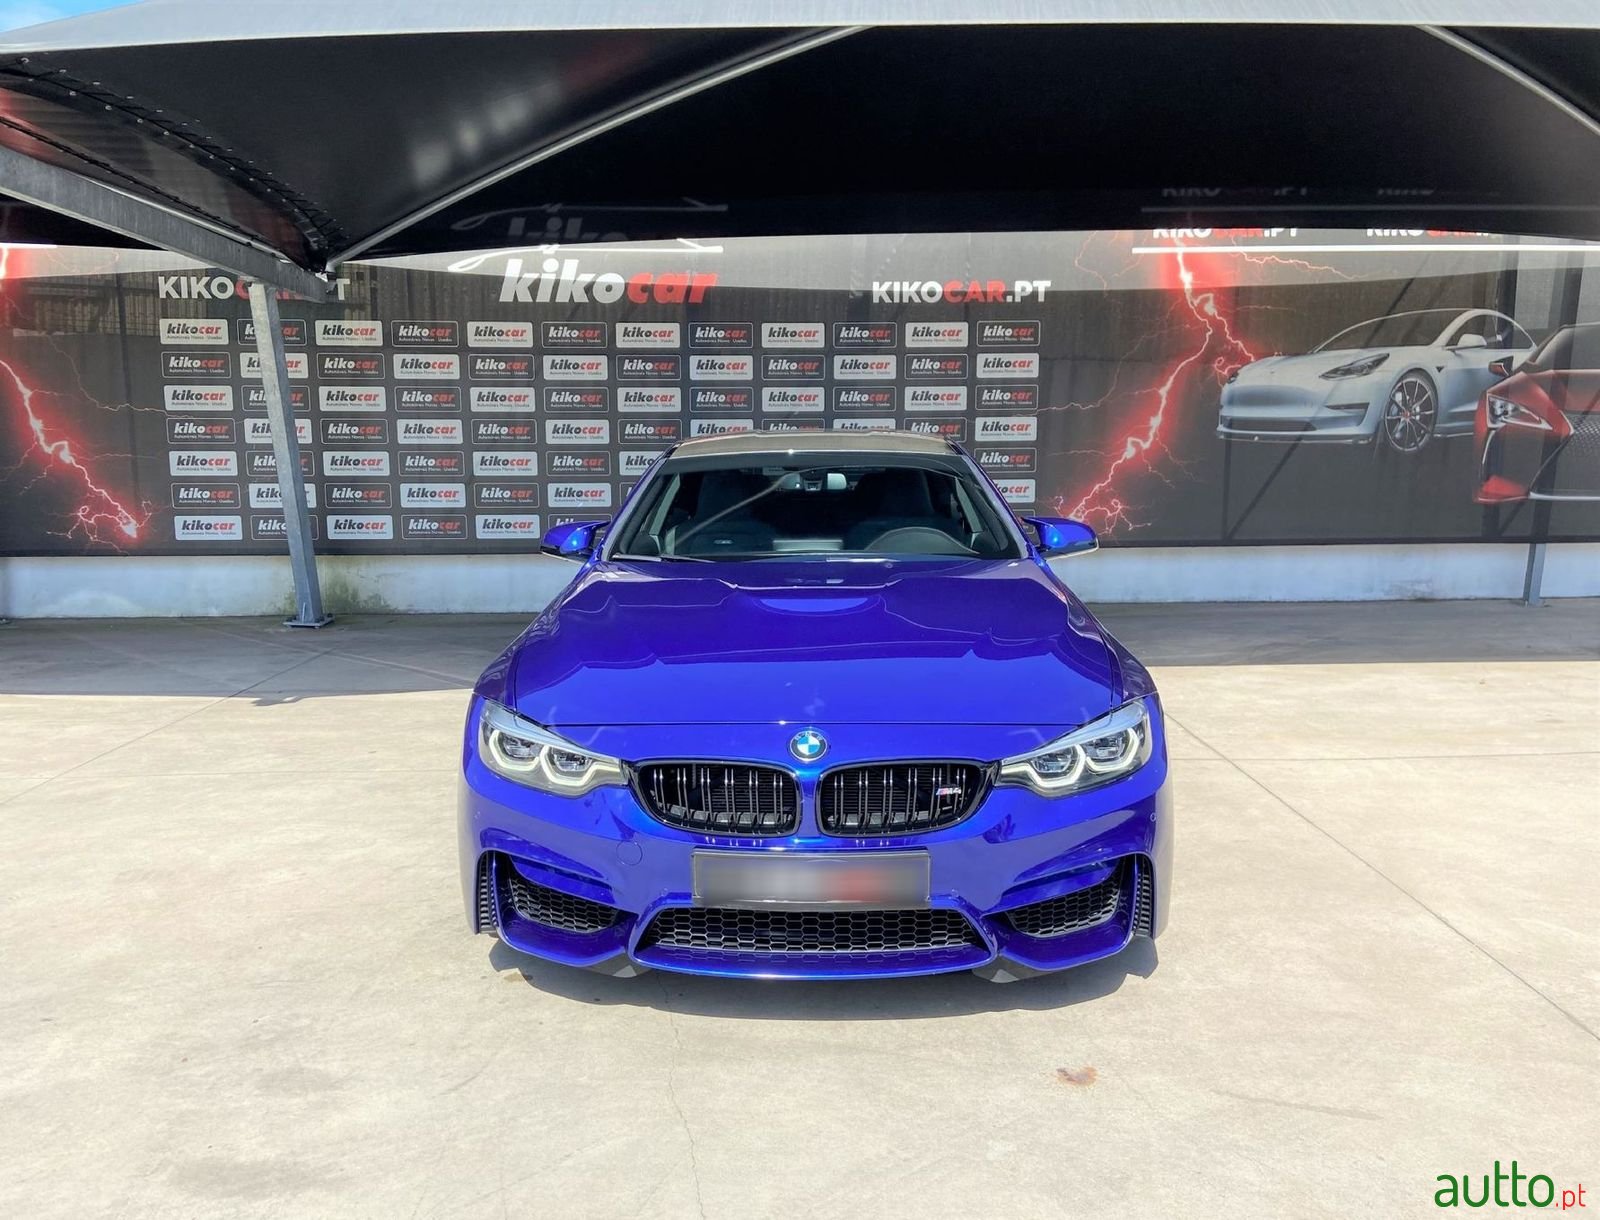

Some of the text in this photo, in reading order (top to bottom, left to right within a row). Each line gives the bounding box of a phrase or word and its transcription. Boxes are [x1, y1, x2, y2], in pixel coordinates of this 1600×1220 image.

[499, 258, 718, 304] kikocar
[158, 276, 350, 300] KIKOCT
[872, 281, 1052, 303] KIKOCAR.PT
[168, 324, 221, 335] kikocar
[323, 325, 375, 336] kikocar
[399, 326, 451, 337] kikocar
[474, 326, 526, 337] kikocar
[549, 327, 600, 338] kikocar
[623, 327, 673, 338] kikocar
[696, 327, 746, 338] kikocar
[768, 327, 819, 338] kikocar
[840, 327, 890, 338] kikocar
[912, 327, 962, 338] kikocar
[984, 326, 1034, 337] kikocar
[170, 357, 223, 368] kikocar
[325, 358, 377, 369] kikocar
[401, 359, 452, 370] kikocar
[476, 359, 528, 370] kikocar
[550, 360, 601, 370] kikocar
[623, 360, 674, 371] kikocar
[696, 360, 746, 371] kikocar
[769, 360, 819, 371] kikocar
[840, 360, 890, 370] kikocar
[912, 359, 961, 370] kikocar
[983, 358, 1033, 369] kikocar
[172, 390, 226, 401] kikocar
[327, 391, 379, 402] kikocar
[402, 391, 454, 402] kikocar
[477, 392, 529, 403] kikocar
[551, 392, 602, 403] kikocar
[624, 392, 675, 403] kikocar
[697, 392, 747, 403] kikocar
[769, 392, 819, 402] kikocar
[840, 391, 890, 402] kikocar
[911, 391, 961, 402] kikocar
[982, 390, 1032, 401] kikocar
[175, 423, 228, 434] kikocar
[328, 424, 381, 434] kikocar
[404, 424, 456, 435] kikocar
[479, 424, 530, 435] kikocar
[552, 424, 603, 435] kikocar
[625, 424, 675, 435] kikocar
[911, 422, 960, 433] kikocar
[981, 422, 1031, 432] kikocar
[177, 456, 230, 467] kikocar
[330, 456, 382, 467] kikocar
[406, 456, 457, 467] kikocar
[480, 456, 532, 467] kikocar
[553, 456, 604, 467] kikocar
[980, 452, 1031, 464] kikocar
[179, 488, 233, 499] kikocar
[332, 488, 384, 499] kikocar
[407, 488, 459, 499] kikocar
[481, 488, 533, 498] kikocar
[554, 488, 606, 498] kikocar
[182, 520, 235, 531] kikocar
[334, 519, 386, 530] kikocar
[409, 519, 461, 530] kikocar
[483, 519, 534, 530] kikocar
